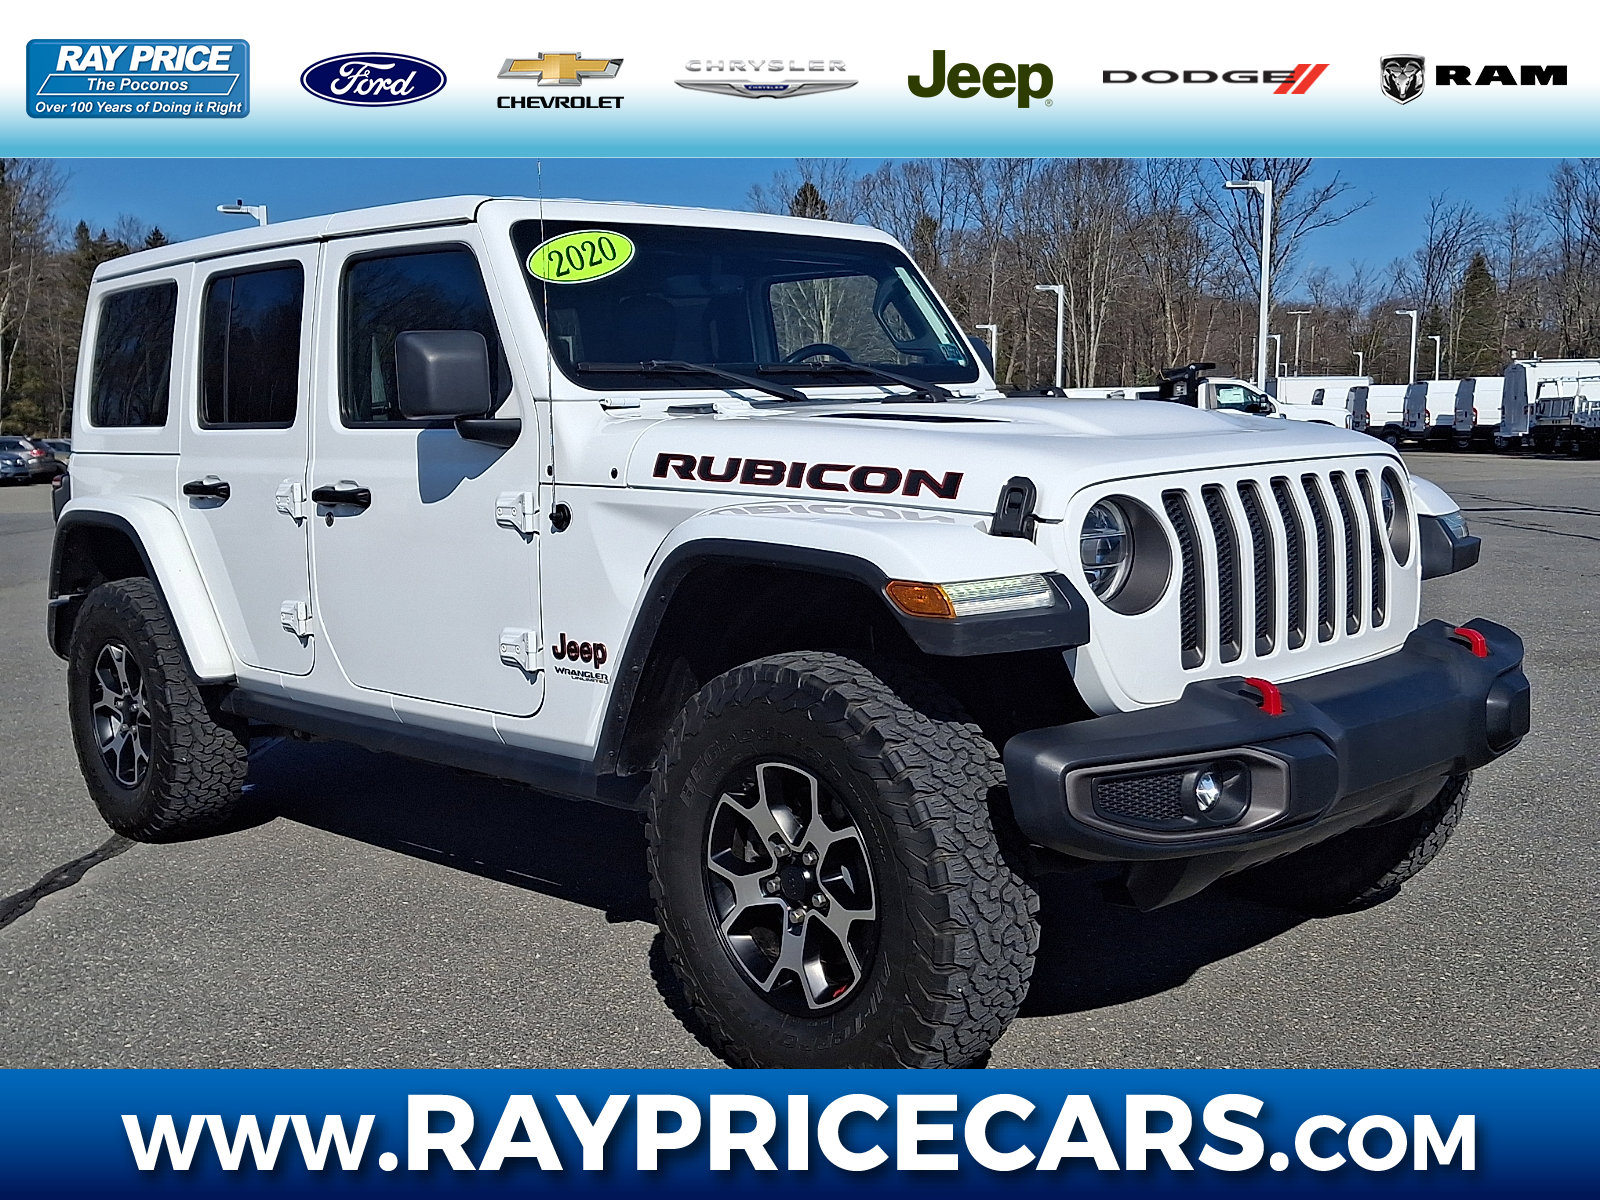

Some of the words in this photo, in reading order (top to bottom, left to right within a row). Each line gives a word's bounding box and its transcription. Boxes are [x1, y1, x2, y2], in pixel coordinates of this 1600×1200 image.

[548, 236, 617, 277] 2020
[653, 452, 964, 499] RUBICON
[552, 632, 607, 669] Jeep
[554, 665, 608, 680] WRANGLER
[571, 675, 608, 684] UNLIMITED
